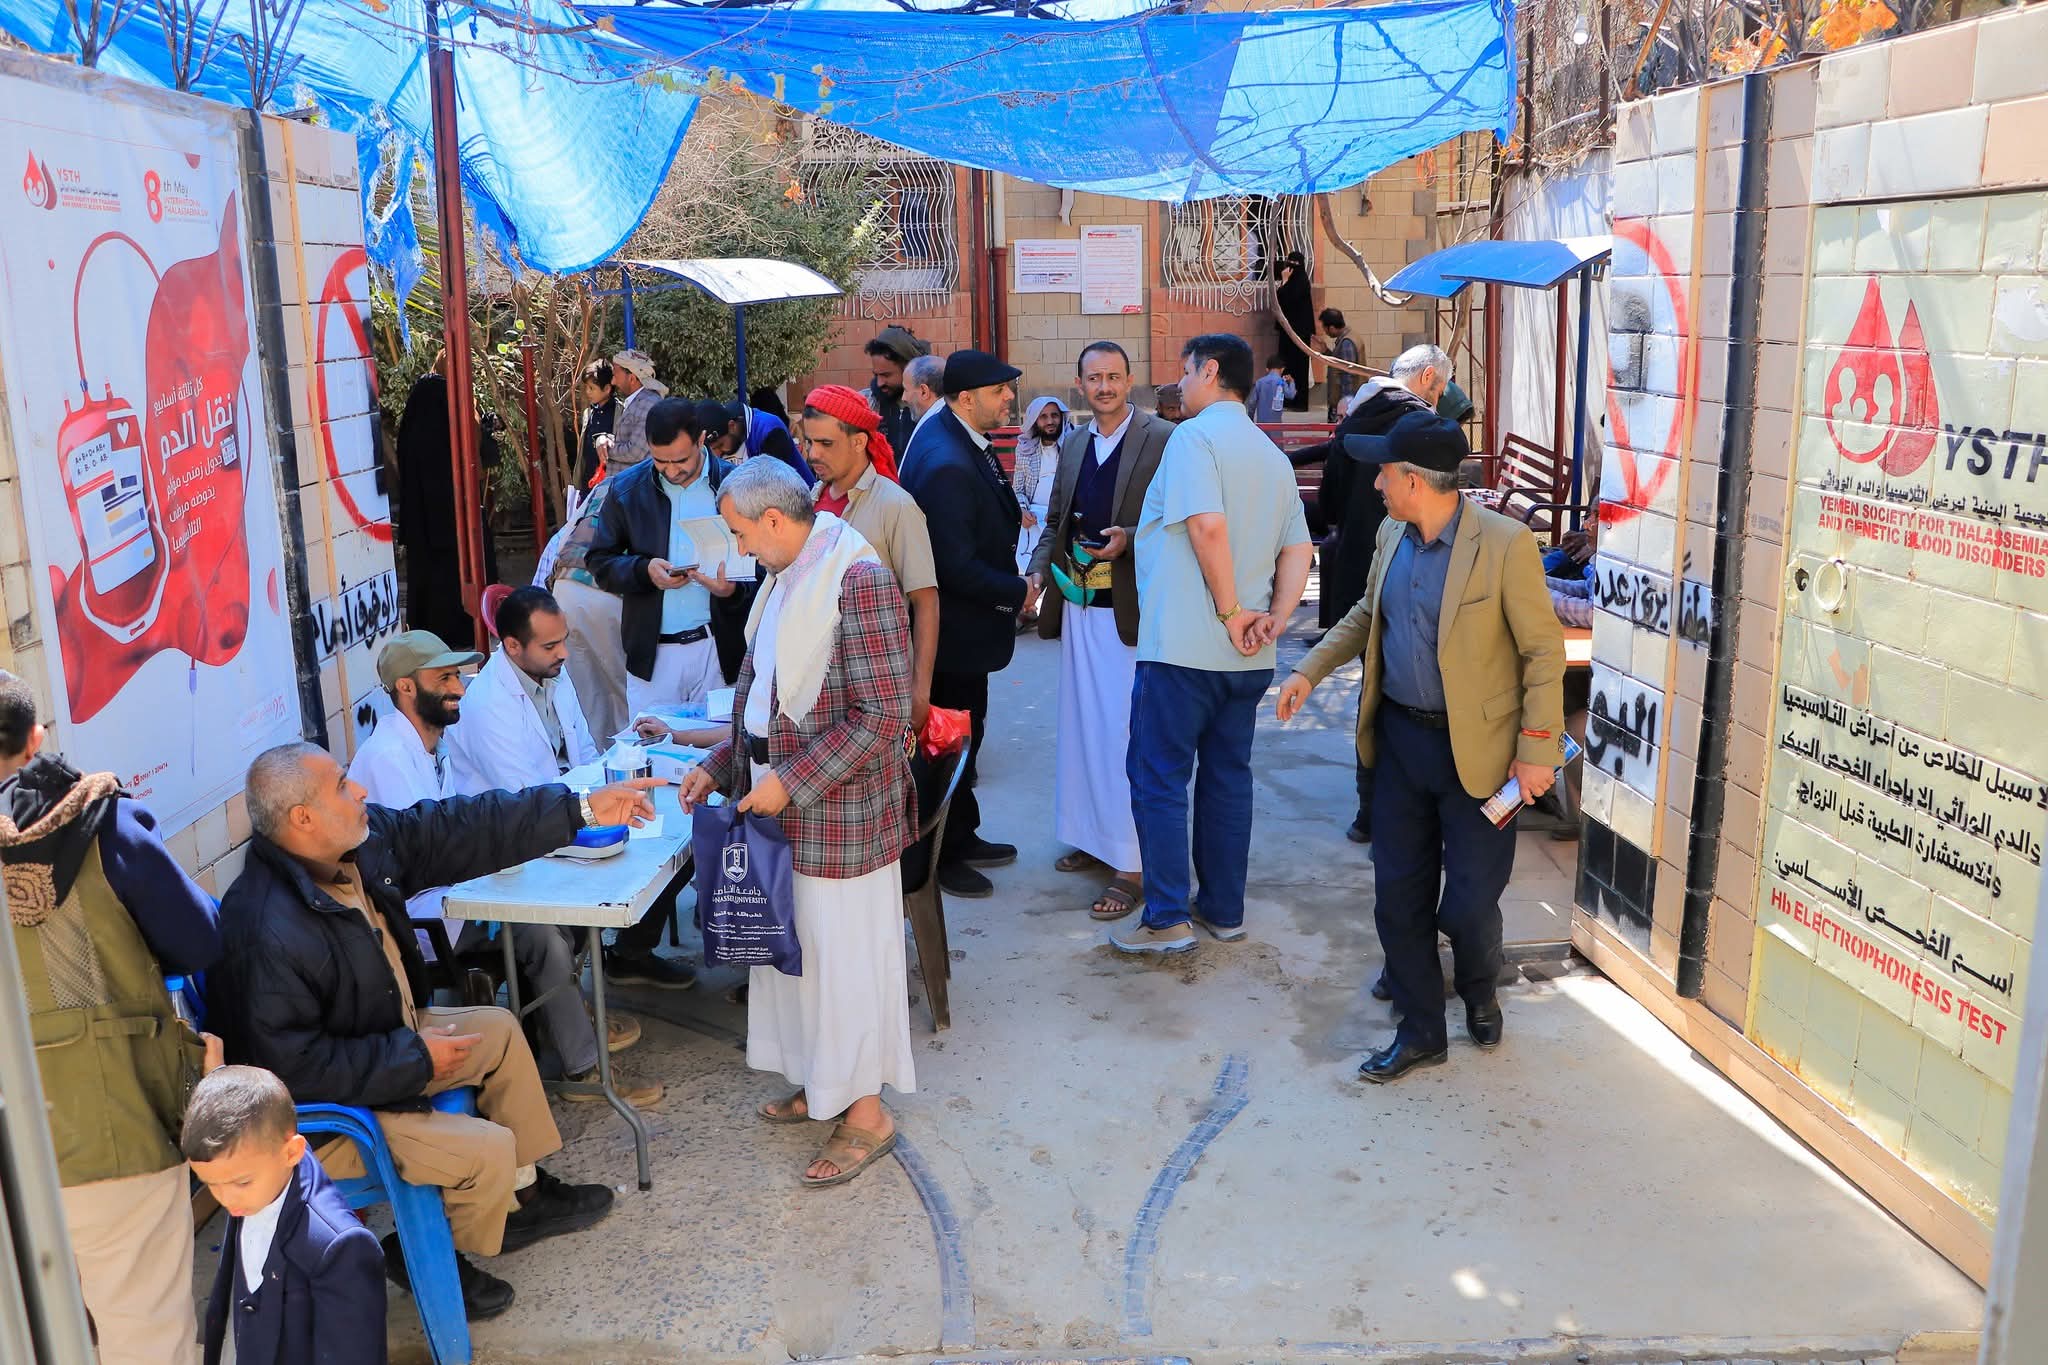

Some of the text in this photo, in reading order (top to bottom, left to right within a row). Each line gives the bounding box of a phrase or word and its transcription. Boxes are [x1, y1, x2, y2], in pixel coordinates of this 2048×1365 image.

[143, 169, 163, 224] 8
[163, 179, 172, 192] th
[174, 180, 189, 197] May
[153, 376, 204, 417] كل ثلاثة أسابيع
[160, 393, 233, 475] نقل الدم
[182, 461, 203, 487] زمني
[205, 455, 223, 476] جدول
[169, 485, 216, 523] يخوضه مرضى
[1819, 495, 2048, 557] YEMEN SOCIETY FOR THALASSEMIA
[1818, 513, 2047, 578] AND GENETIC BLOOD DISORDERS
[1783, 684, 1847, 728] الثلاسيميا
[1781, 729, 1820, 763] المبكر
[1898, 737, 1920, 757] من
[1821, 753, 1872, 783] الفحص
[1924, 750, 1984, 782] للخلاص
[1986, 767, 2033, 803] سبيل
[1839, 798, 1864, 826] قبل
[1868, 810, 1913, 848] الطبية
[1936, 796, 1992, 837] الوراثي
[1915, 832, 2002, 898] والاستشارة
[1994, 828, 2042, 867] والدم
[713, 884, 762, 897] جامعة الناص
[734, 895, 768, 905] UNIVERSITY
[1865, 906, 1951, 960] الفحص
[1771, 887, 2008, 1046] Hb ELECTROPHORESIS TEST
